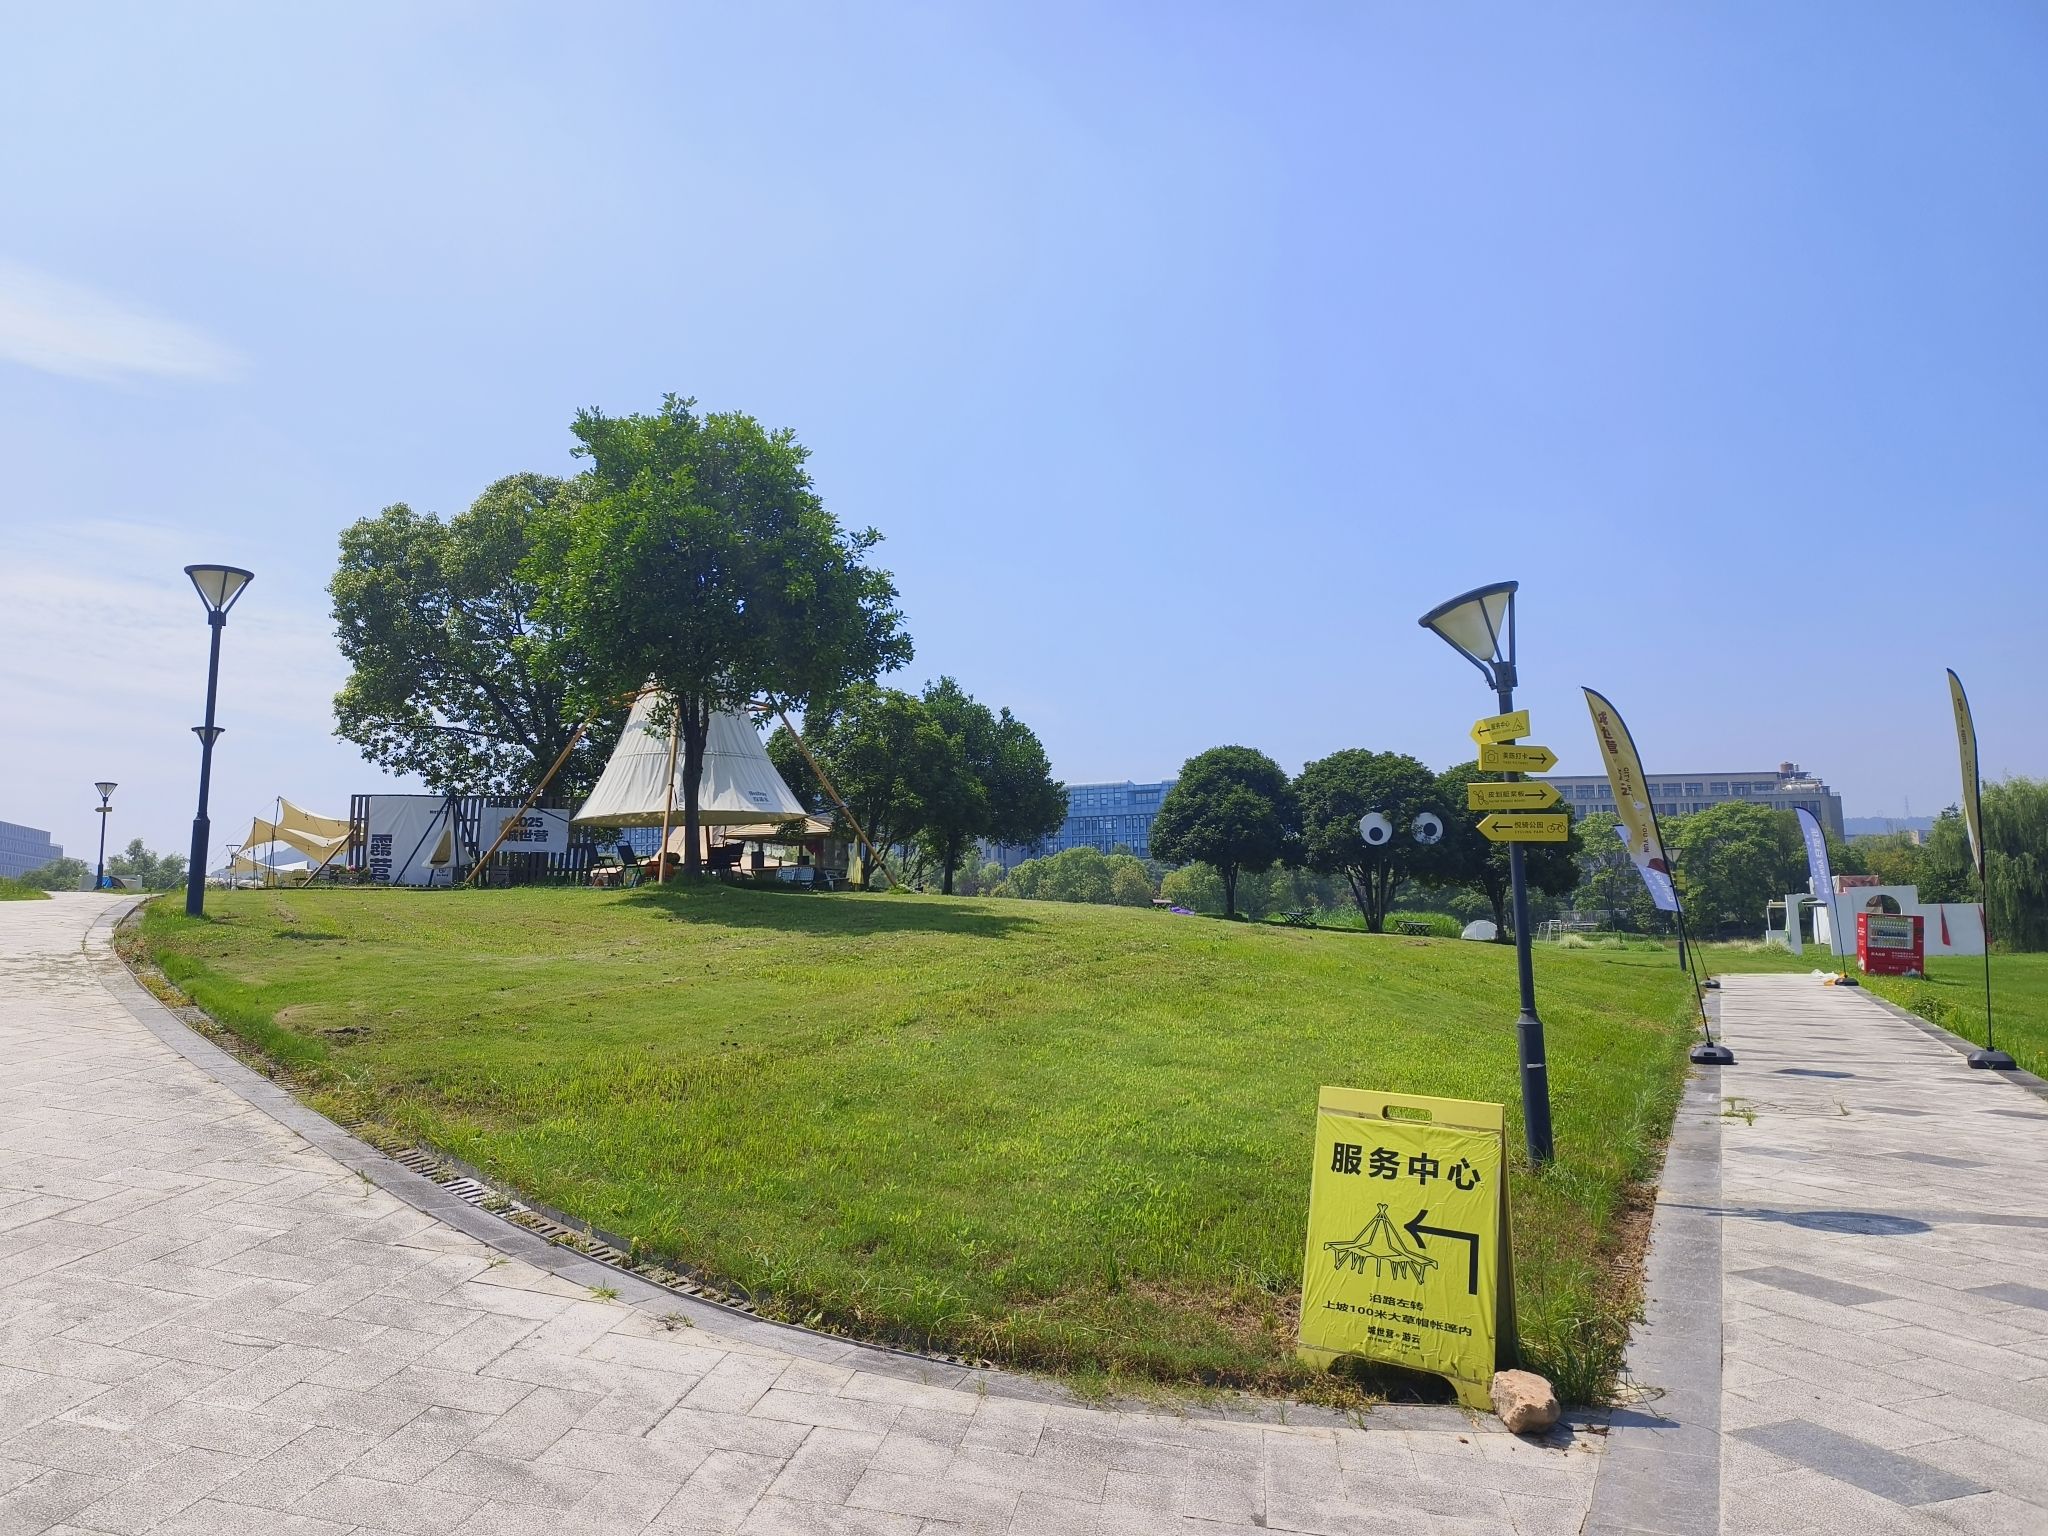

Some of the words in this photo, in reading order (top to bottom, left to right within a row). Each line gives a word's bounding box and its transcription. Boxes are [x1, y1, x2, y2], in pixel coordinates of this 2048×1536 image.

[1331, 1142, 1481, 1191] 服务中心
[1322, 1300, 1472, 1337] 上坡100米大草帽帐篷内
[1369, 1293, 1424, 1311] 沿路左转
